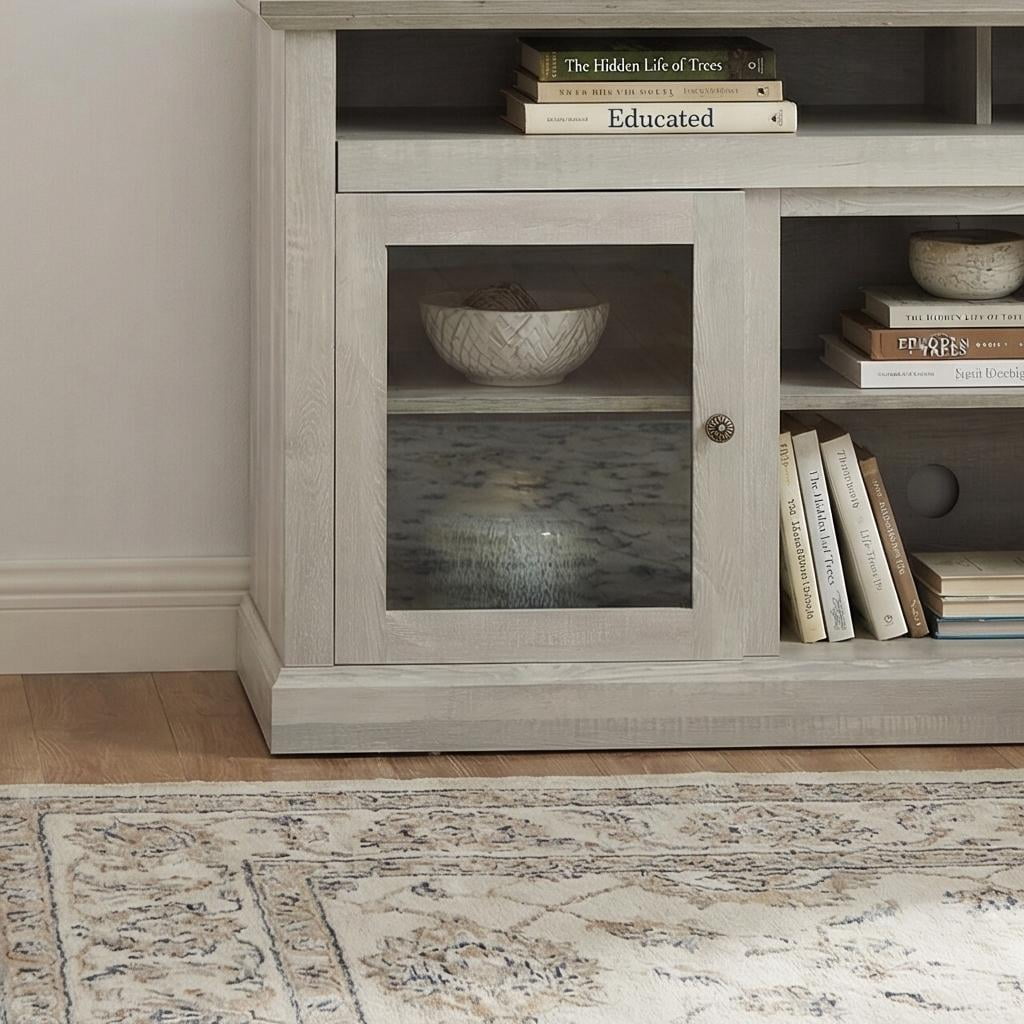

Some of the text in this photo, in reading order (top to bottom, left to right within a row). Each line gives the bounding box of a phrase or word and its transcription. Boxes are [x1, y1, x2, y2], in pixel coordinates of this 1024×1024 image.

[565, 58, 590, 73] The
[594, 57, 640, 73] Hidden
[644, 57, 669, 72] Life
[672, 57, 687, 72] of
[689, 57, 723, 72] Trees
[608, 107, 715, 128] Educated
